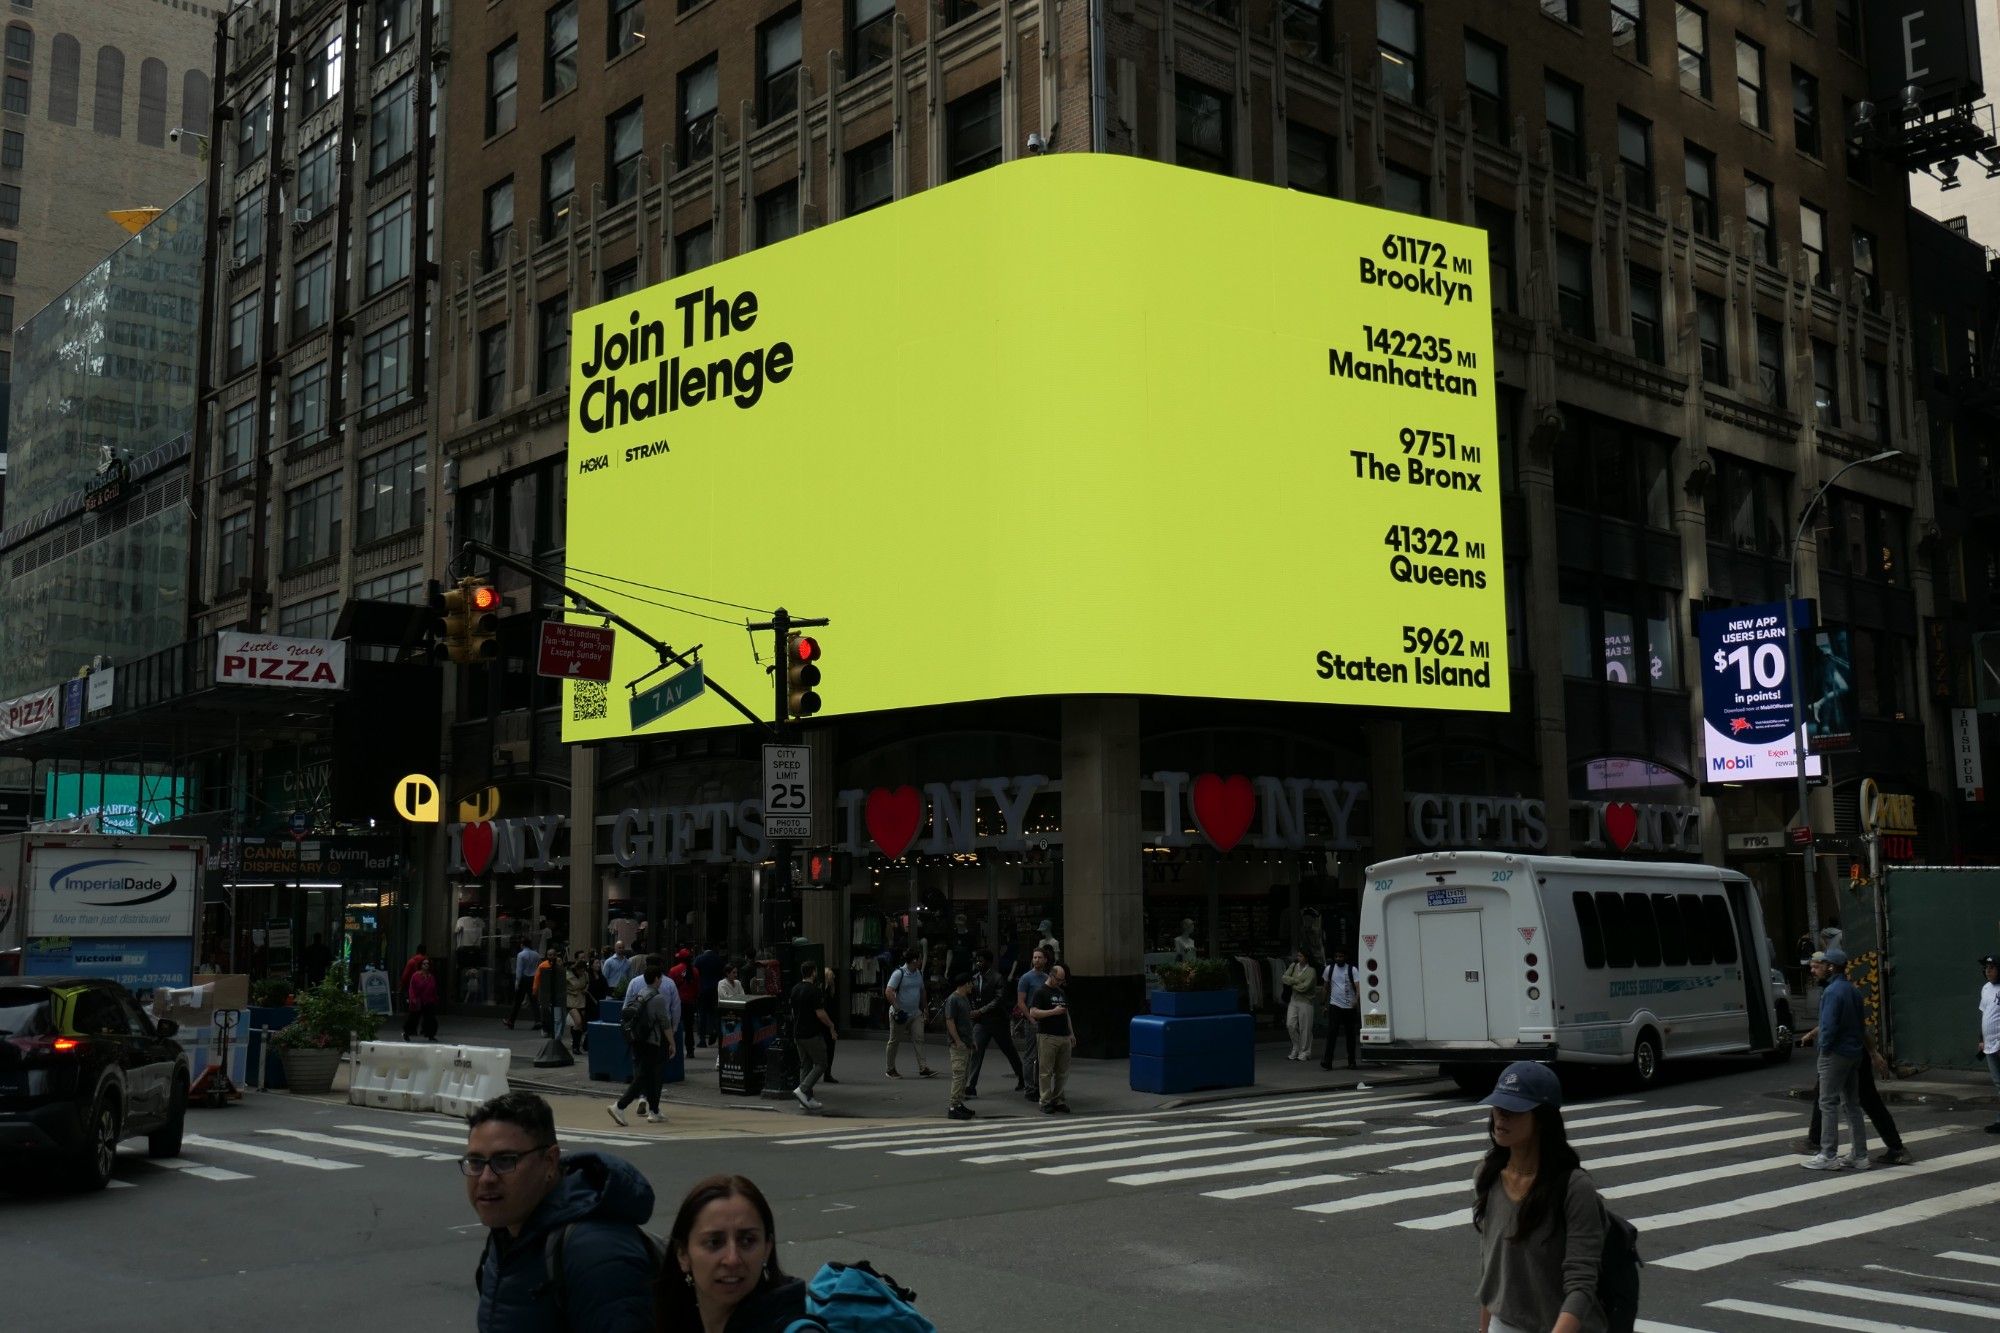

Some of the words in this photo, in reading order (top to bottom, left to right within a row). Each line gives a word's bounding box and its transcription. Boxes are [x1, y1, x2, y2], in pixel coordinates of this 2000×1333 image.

[1382, 233, 1447, 269] 61172
[1453, 256, 1472, 275] MI
[1360, 256, 1472, 306] Brooklyn
[581, 310, 664, 379] Join
[675, 286, 758, 349] The
[1363, 325, 1453, 364] 142235
[1457, 350, 1476, 369] MI
[1329, 348, 1477, 397] Manhattan
[580, 342, 793, 434] Challenge
[579, 455, 609, 475] HOKA
[625, 439, 670, 462] STRAVA
[1399, 427, 1456, 460] 9751
[1461, 445, 1480, 463] MI
[1350, 450, 1400, 483] The
[1408, 457, 1482, 492] Bronx
[1384, 525, 1459, 558] 41322
[1465, 542, 1485, 559] MI
[1390, 555, 1486, 589] Queens
[556, 627, 566, 635] No
[569, 629, 600, 640] Standing
[1722, 632, 1754, 643] USERS
[1757, 627, 1786, 639] EARN
[1728, 619, 1753, 631] NEW
[1756, 617, 1777, 627] APP
[237, 641, 279, 652] Little
[287, 645, 325, 656] Italy
[544, 635, 575, 646] 7am-9am
[579, 641, 611, 652] 4pm-7pm
[550, 647, 574, 658] Except
[577, 650, 602, 662] Sunday
[1402, 625, 1464, 656] 5962
[1470, 641, 1489, 658] MI
[224, 656, 336, 683] PIZZA
[1316, 650, 1408, 683] Staten
[1415, 657, 1490, 688] Island
[1713, 643, 1786, 690] $10
[653, 692, 661, 711] 7
[1735, 693, 1745, 703] in
[1747, 690, 1781, 704] points!
[1960, 711, 1971, 753] IRISH
[773, 761, 800, 769] SPEED
[1713, 755, 1753, 770] Mobil
[1768, 750, 1788, 758] Exxon
[777, 772, 797, 780] LIMIT
[1964, 759, 1973, 784] PUB
[771, 784, 806, 809] 25
[835, 789, 868, 857] I
[922, 775, 1049, 855] NY
[1152, 771, 1192, 848] I
[1253, 776, 1368, 849] NY
[1409, 794, 1549, 849] GIFTS
[612, 799, 768, 868] GIFTS
[1636, 804, 1700, 850] NY
[329, 848, 368, 861] twinn
[493, 814, 565, 874] NY
[243, 861, 323, 873] DISPENSARY
[365, 857, 391, 868] leaf
[65, 878, 162, 892] ImperialDade
[1375, 880, 1393, 891] 207
[1492, 871, 1513, 882] 207
[53, 914, 77, 924] More
[79, 914, 98, 923] than
[100, 914, 117, 925] just
[119, 914, 171, 924] distribution!
[1610, 981, 1637, 997] EXPRESS
